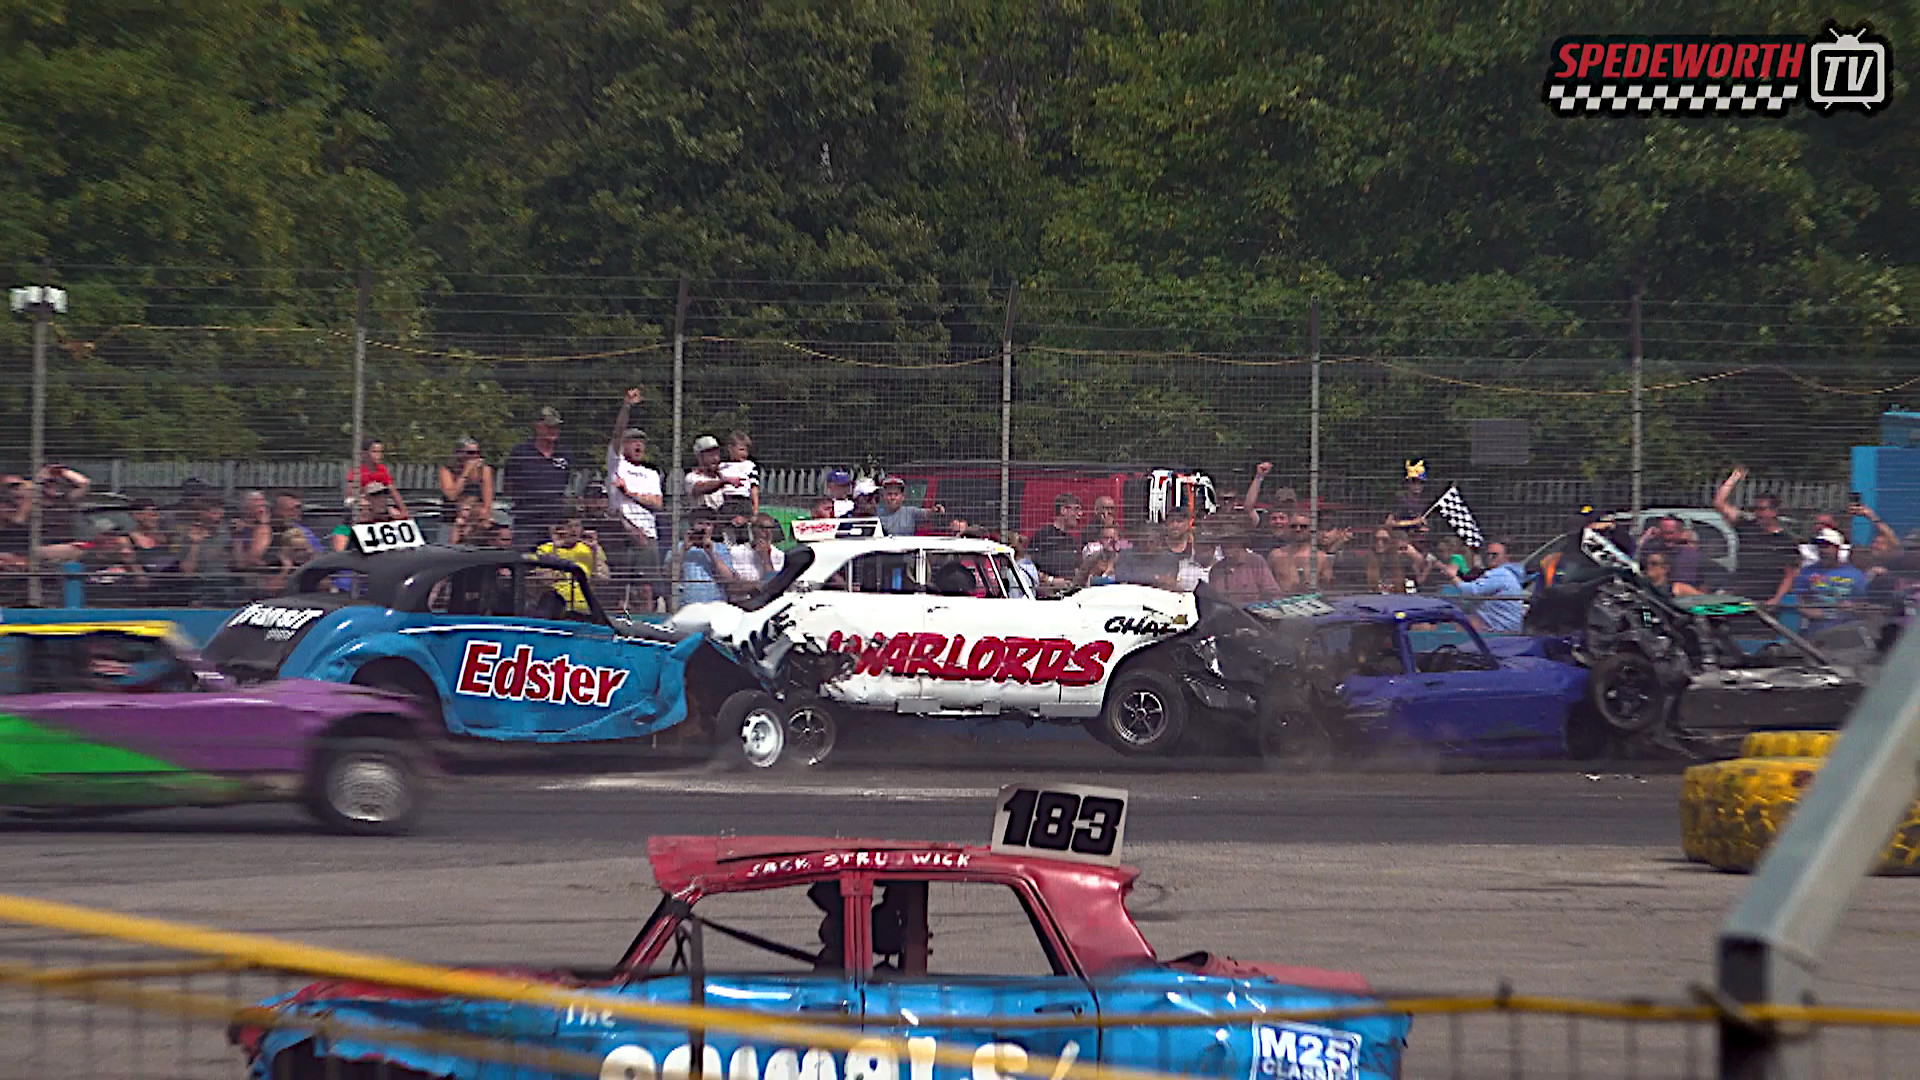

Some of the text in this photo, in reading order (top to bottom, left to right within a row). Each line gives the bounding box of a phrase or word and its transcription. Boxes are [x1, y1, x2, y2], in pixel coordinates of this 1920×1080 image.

[365, 522, 414, 548] 160
[456, 640, 630, 707] Edster
[1002, 789, 1124, 856] 183
[746, 858, 812, 878] JACK
[1260, 1026, 1350, 1074] M25
